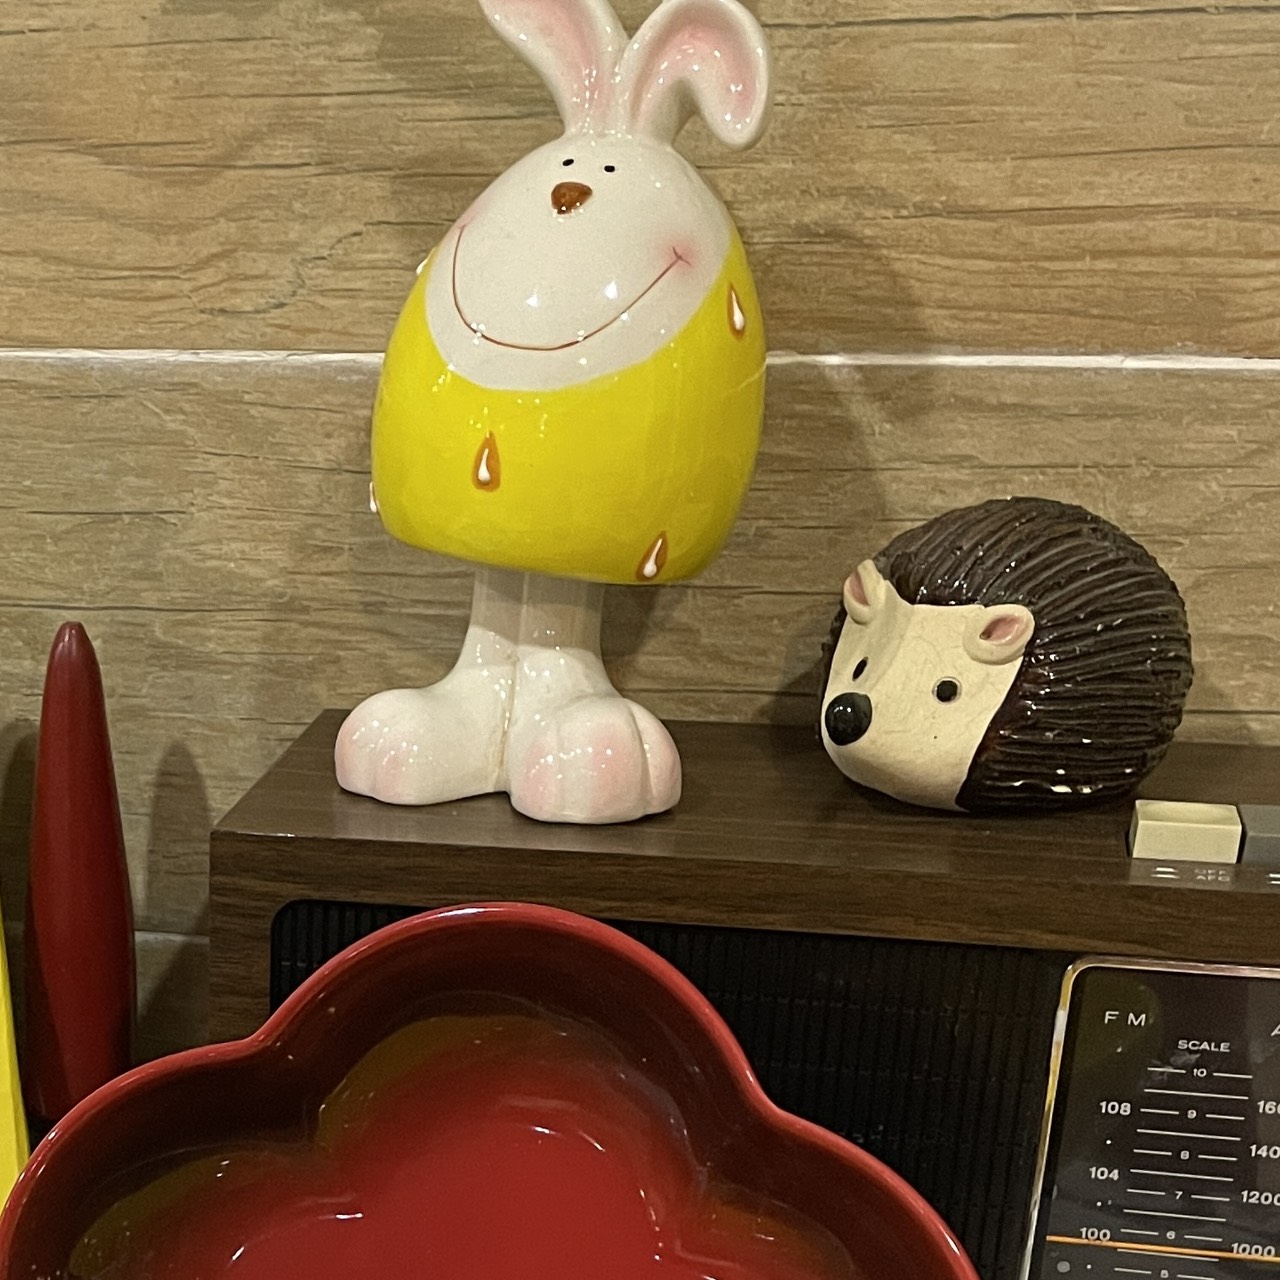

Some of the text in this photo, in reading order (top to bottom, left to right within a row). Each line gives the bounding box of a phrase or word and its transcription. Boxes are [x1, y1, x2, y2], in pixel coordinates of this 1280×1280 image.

[1177, 1039, 1231, 1053] SCALE
[1193, 1068, 1207, 1078] 10
[1099, 1101, 1131, 1116] 108
[1187, 1109, 1197, 1119] 9
[1180, 1150, 1190, 1160] 8
[1089, 1166, 1119, 1181] 104
[1175, 1190, 1183, 1200] 7
[1079, 1227, 1111, 1242] 100
[1166, 1230, 1176, 1240] 6
[1230, 1242, 1276, 1257] 1000
